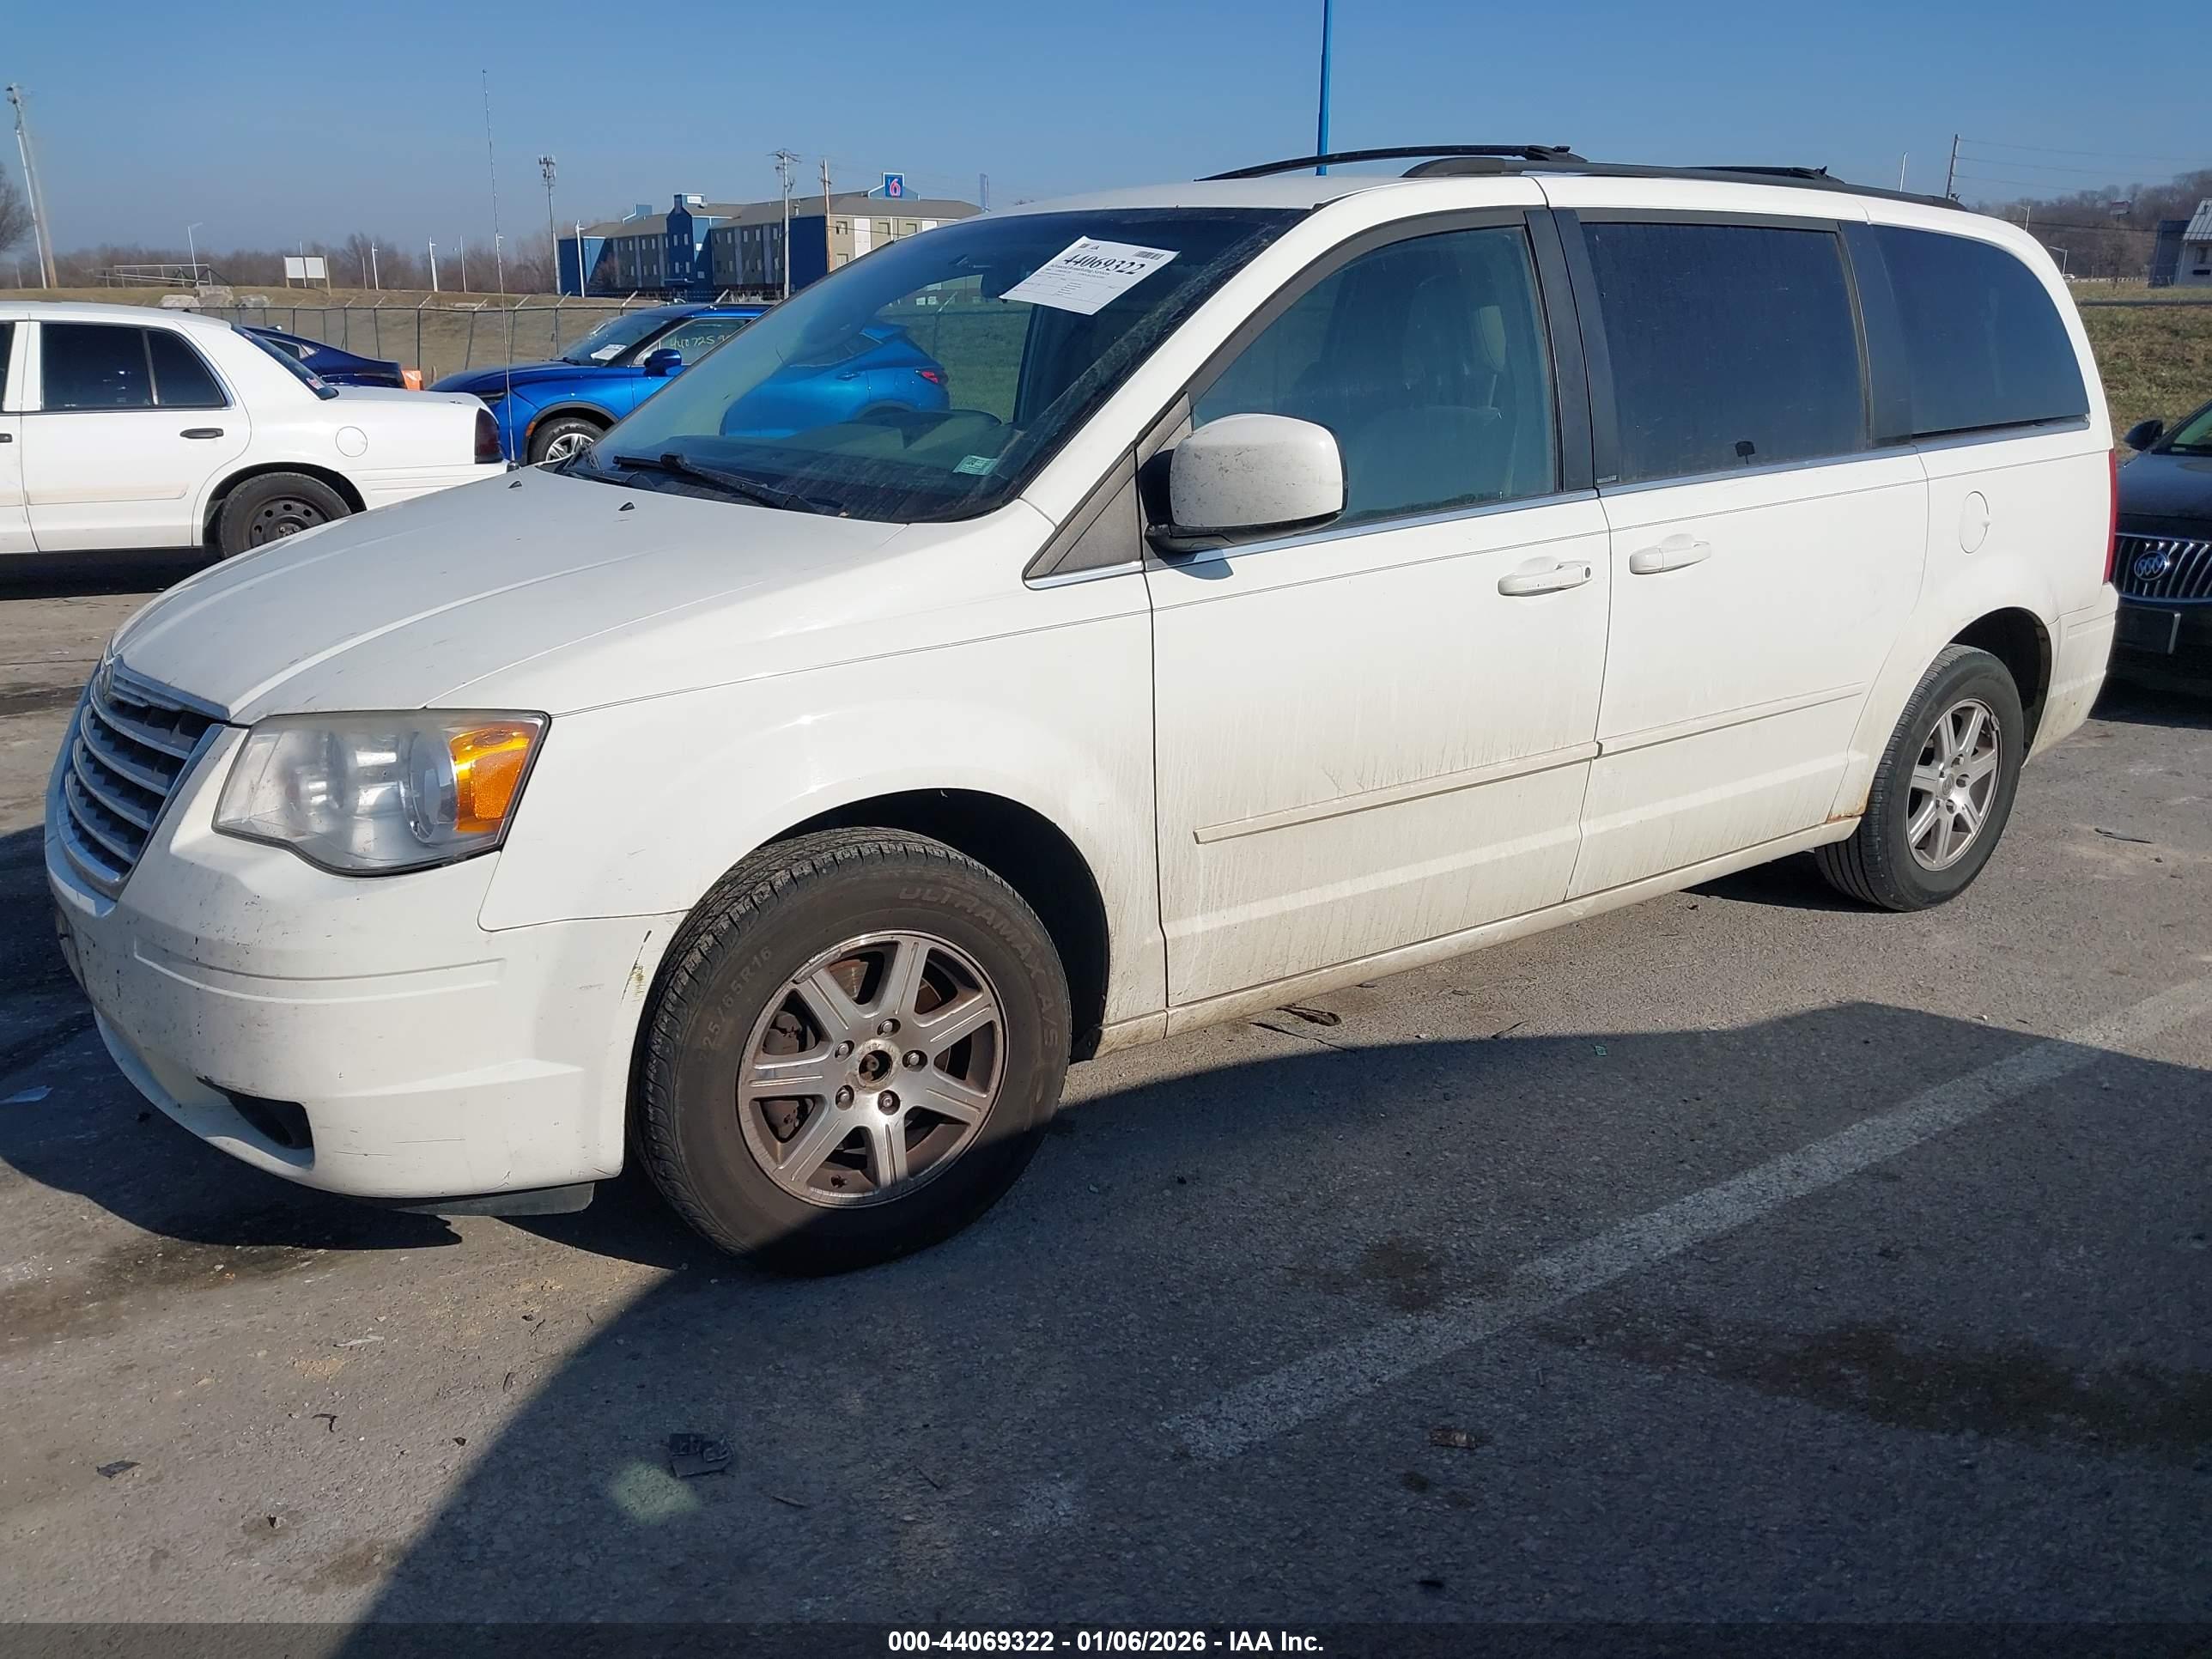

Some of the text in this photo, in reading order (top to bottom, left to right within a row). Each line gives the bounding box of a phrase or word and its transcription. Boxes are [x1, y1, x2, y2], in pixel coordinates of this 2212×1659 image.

[889, 178, 901, 197] 6
[1063, 252, 1146, 276] 44069322
[898, 884, 1059, 1049] ULTRAMAX A/S
